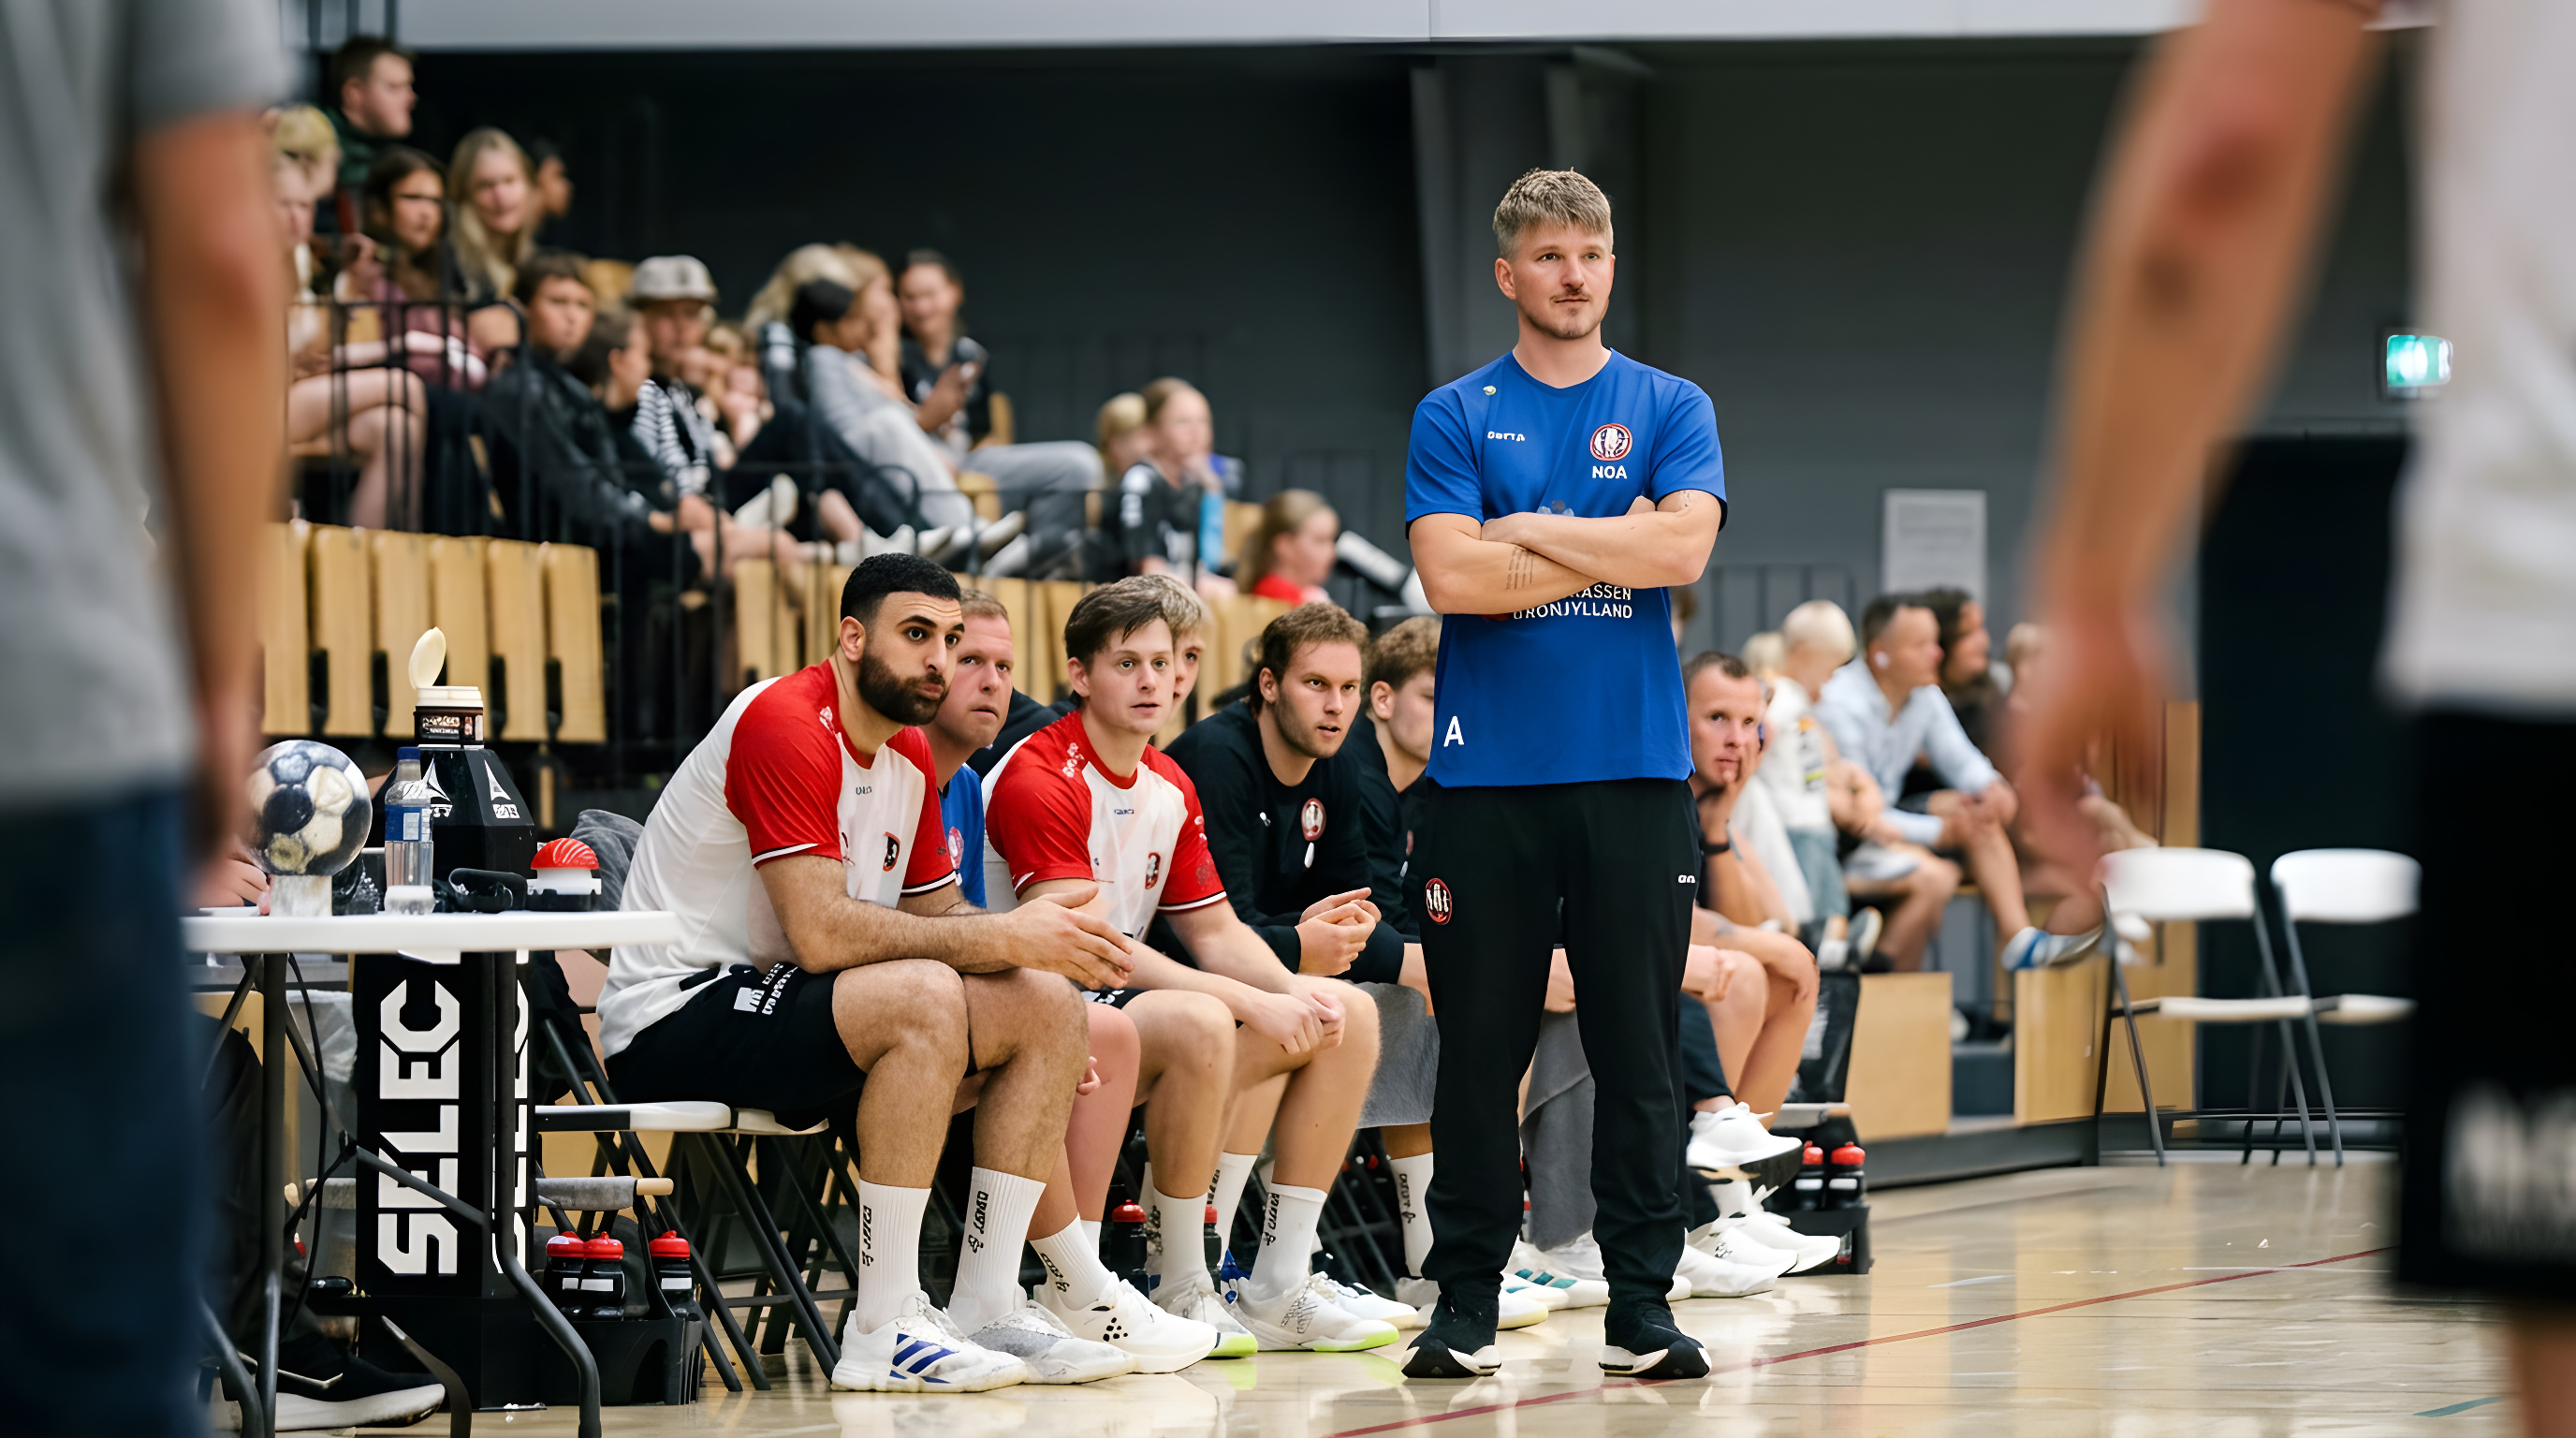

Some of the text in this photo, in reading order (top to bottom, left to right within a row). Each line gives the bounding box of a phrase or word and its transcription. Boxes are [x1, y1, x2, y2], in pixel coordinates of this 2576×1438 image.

[1592, 464, 1628, 479] NOA
[1570, 583, 1632, 601] ASSEN
[1442, 714, 1465, 748] A
[377, 949, 461, 1277] SELEC
